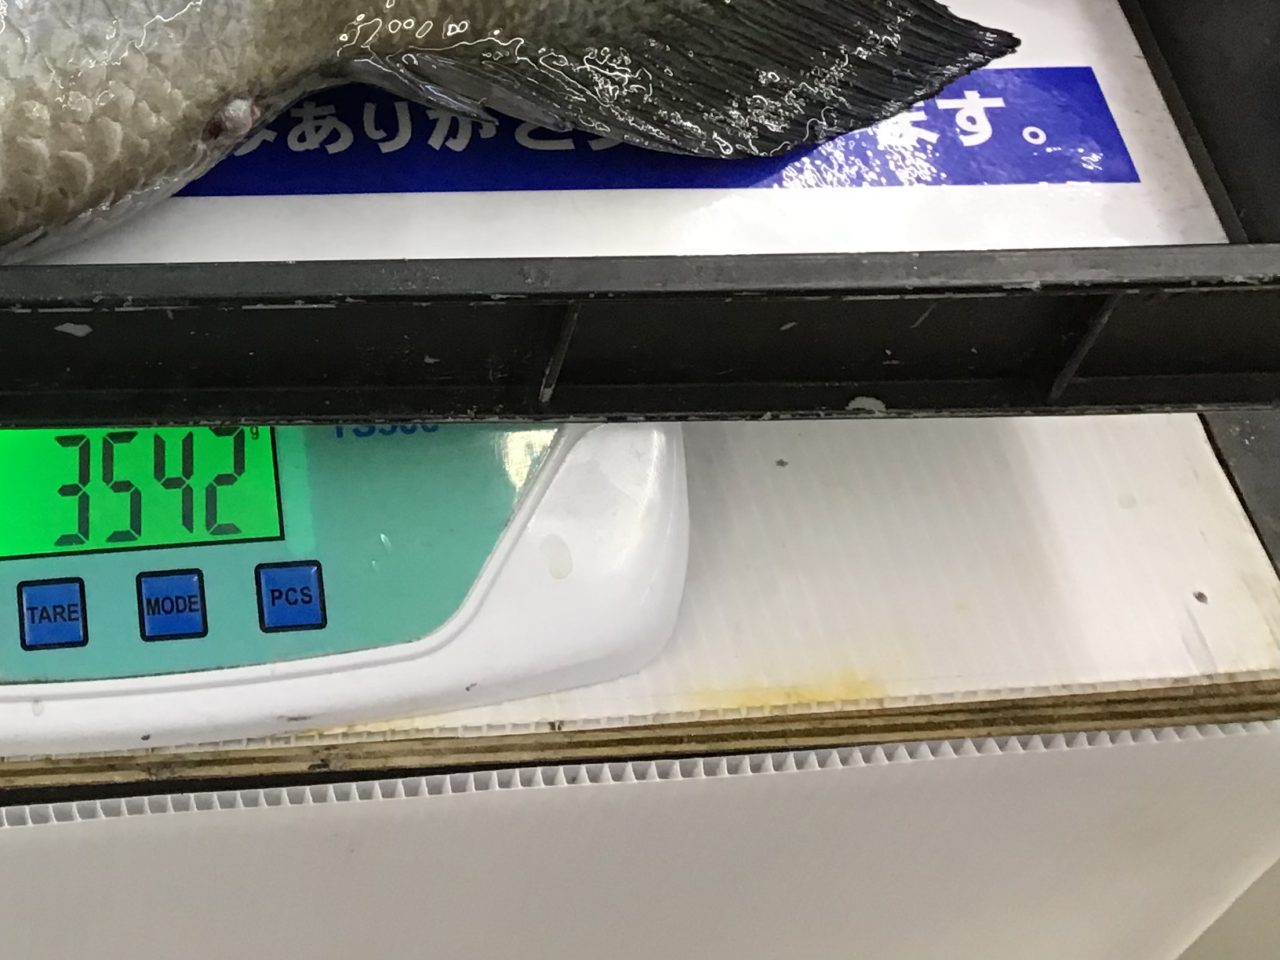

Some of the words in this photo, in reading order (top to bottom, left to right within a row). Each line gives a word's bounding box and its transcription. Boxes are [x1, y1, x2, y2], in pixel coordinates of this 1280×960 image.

[54, 425, 246, 547] 3542
[26, 603, 81, 625] TARE
[145, 594, 201, 617] MODE
[269, 586, 314, 607] PCS
